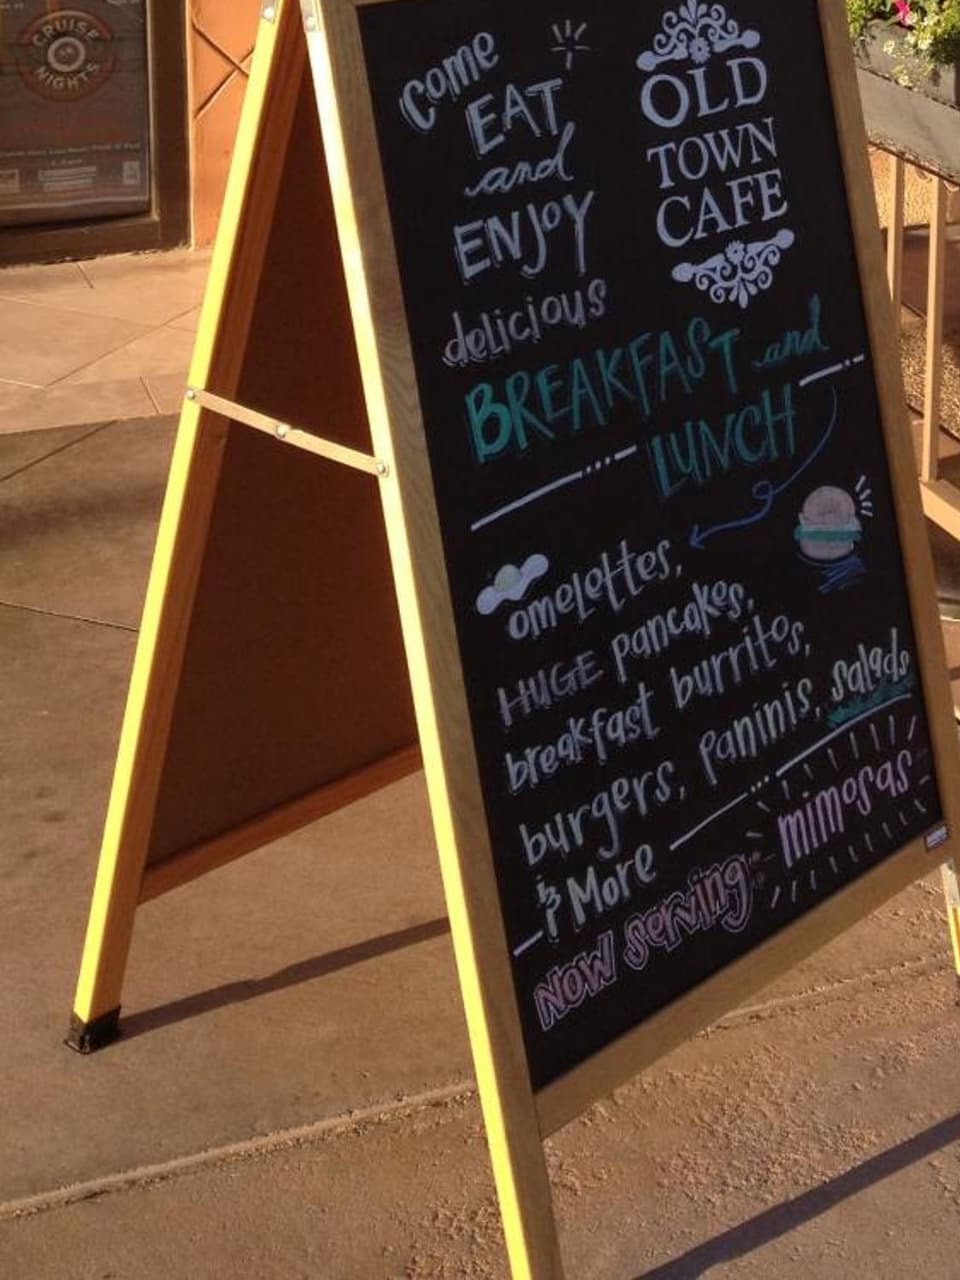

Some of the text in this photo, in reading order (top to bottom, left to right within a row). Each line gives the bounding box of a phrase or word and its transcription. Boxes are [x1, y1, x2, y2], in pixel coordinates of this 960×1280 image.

[32, 18, 100, 47] CRUISE
[35, 62, 100, 89] NIGHTS
[400, 31, 499, 131] come
[465, 78, 562, 157] EAT
[640, 57, 767, 127] OLD
[465, 122, 575, 198] and
[647, 118, 779, 188] TOWN
[656, 169, 788, 247] CAFE
[442, 278, 607, 366] delicious
[464, 293, 829, 464] BREAKFAST and
[648, 383, 795, 498] LUNCH
[508, 539, 682, 640] omelettes,
[498, 580, 755, 726] HUGE pancakes,
[506, 615, 811, 794] breakfast burritos,
[519, 627, 909, 866] burgers, paninis, salads
[777, 749, 912, 868] mimosas
[566, 844, 657, 932] More
